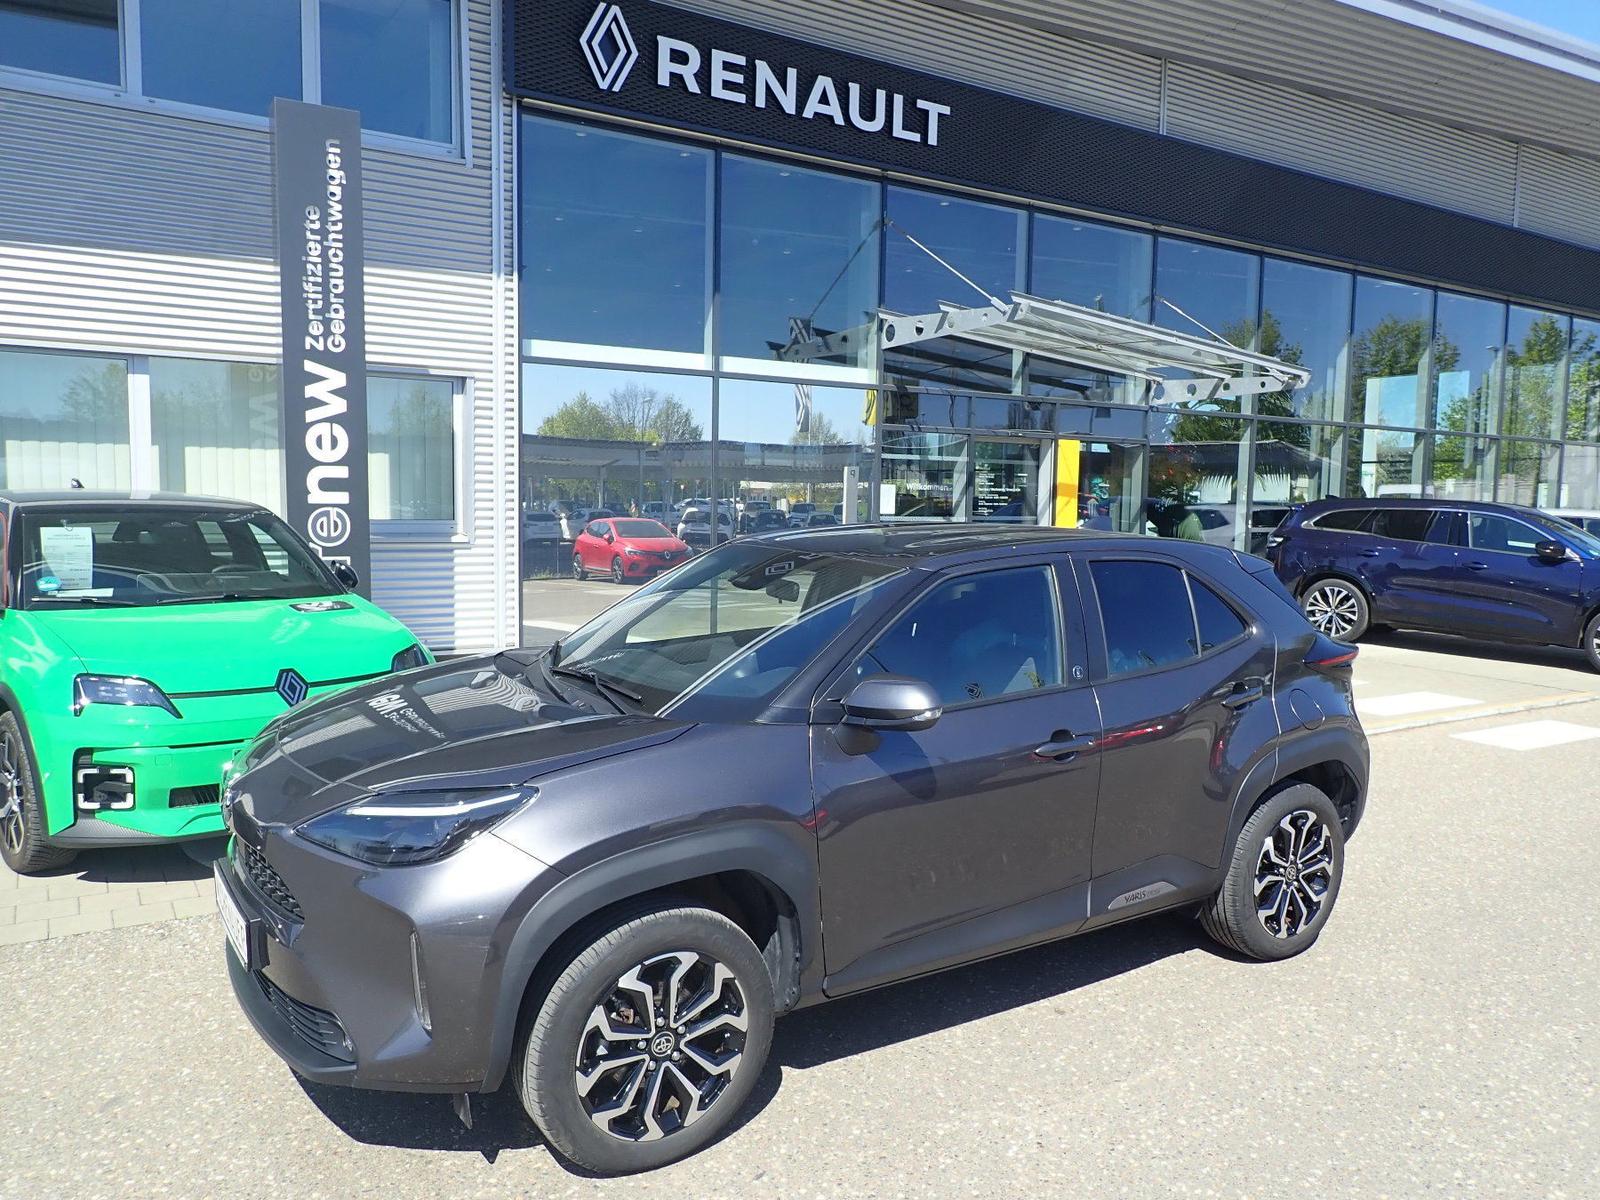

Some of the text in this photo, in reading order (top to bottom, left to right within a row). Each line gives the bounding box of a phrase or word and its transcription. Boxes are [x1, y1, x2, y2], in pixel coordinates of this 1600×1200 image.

[656, 35, 951, 147] RENAULT
[302, 204, 325, 352] Zertifizierte
[323, 138, 347, 353] Gebrauchtwagen
[1124, 890, 1147, 904] YARIS
